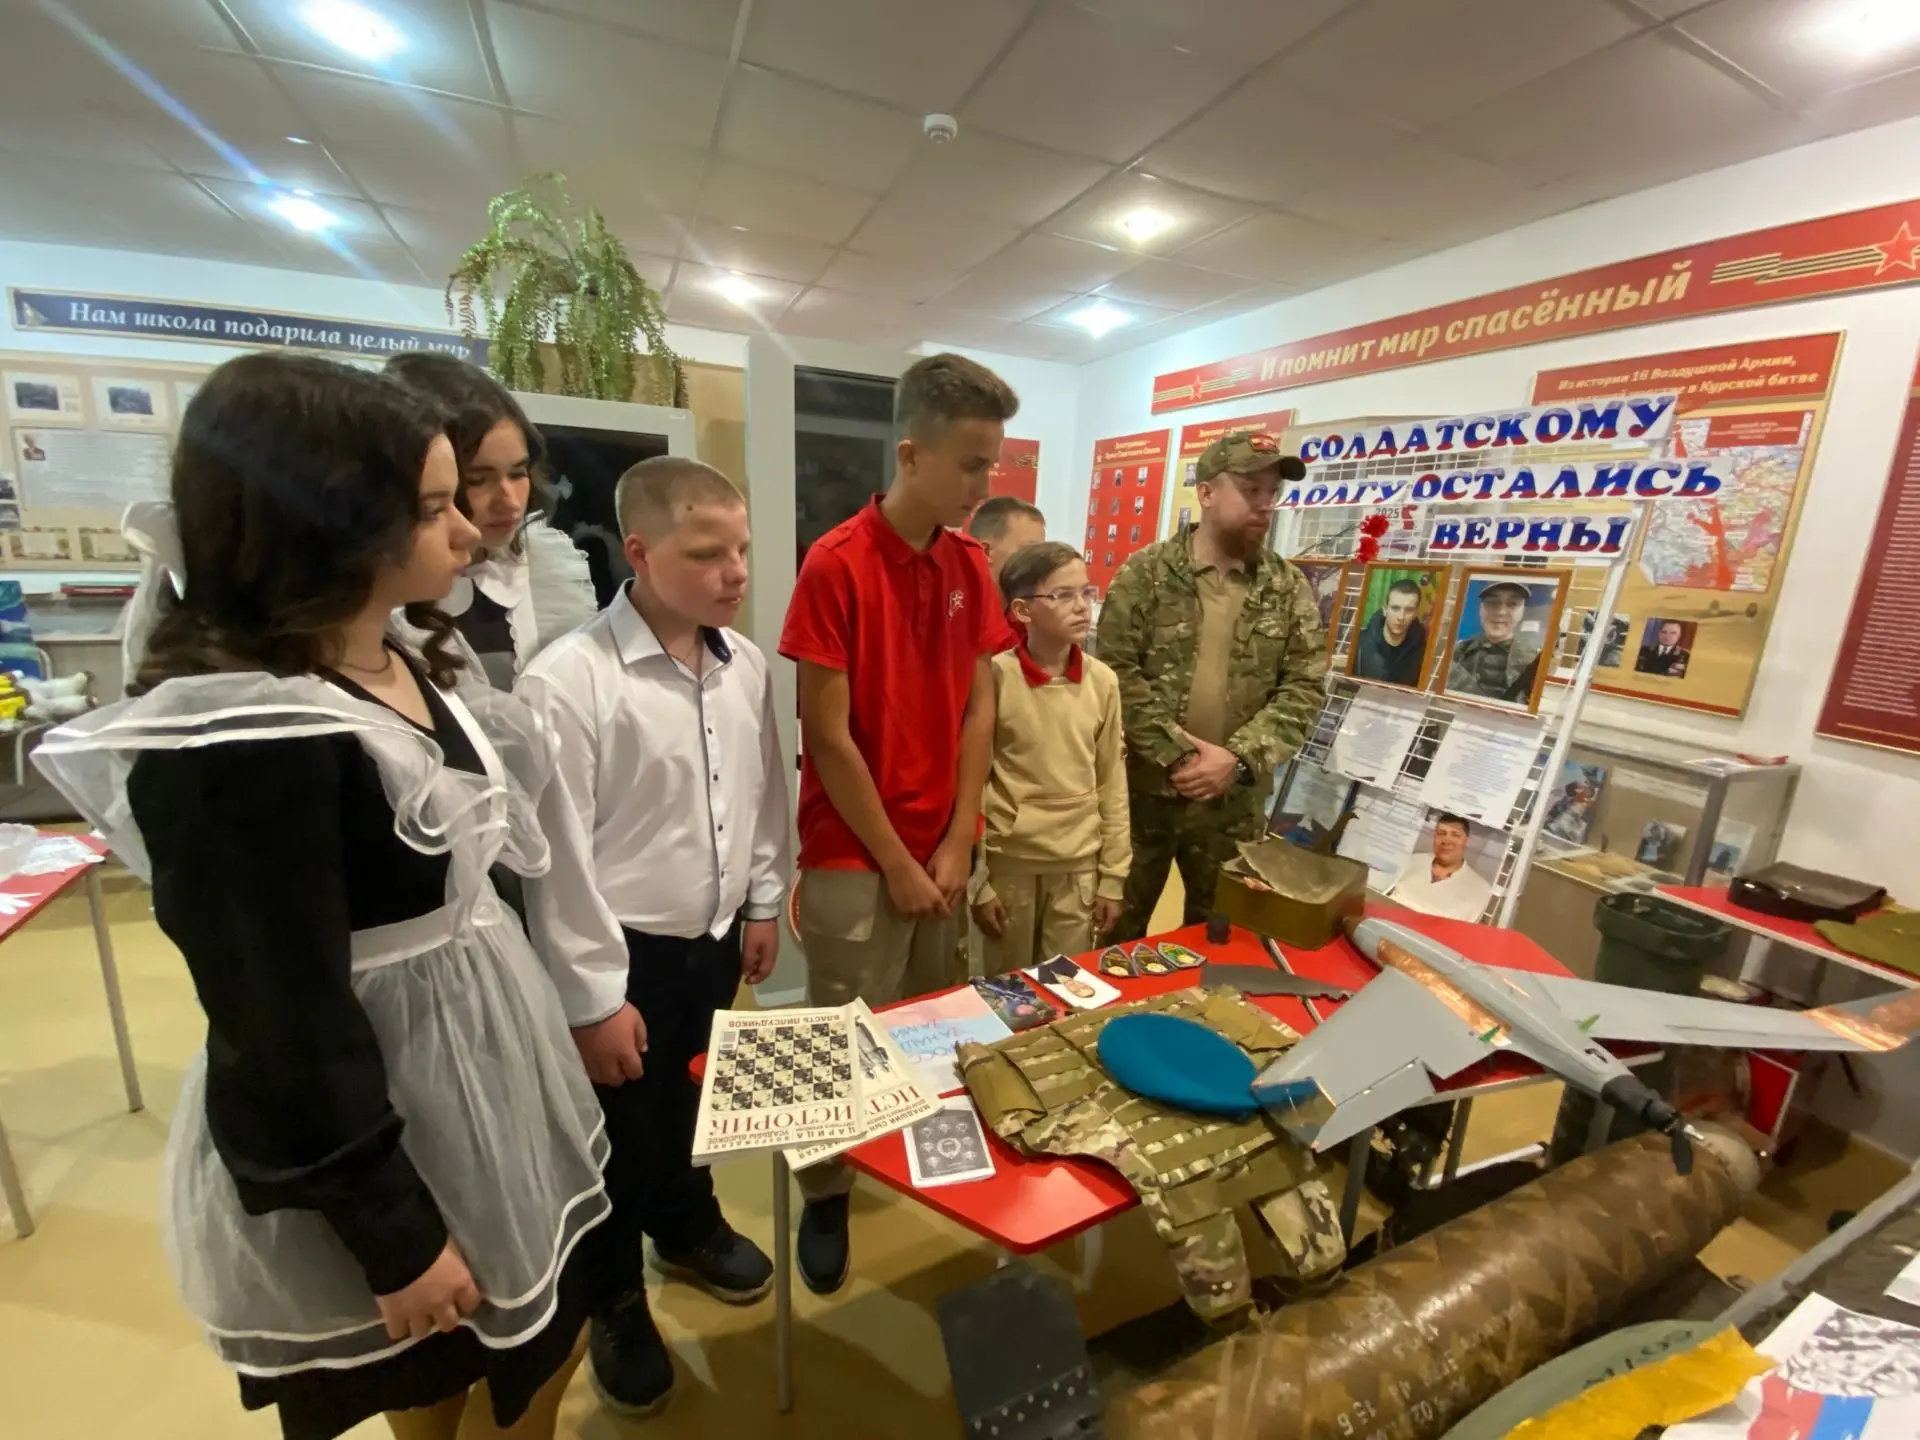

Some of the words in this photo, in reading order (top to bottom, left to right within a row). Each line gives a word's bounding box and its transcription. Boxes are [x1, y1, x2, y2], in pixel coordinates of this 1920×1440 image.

[69, 301, 126, 326] Нам
[135, 311, 217, 333] школа
[224, 316, 342, 345] подарила
[349, 331, 421, 352] целый
[1260, 356, 1276, 382] И
[1278, 339, 1376, 378] помнит
[1377, 325, 1440, 357] мир
[1444, 260, 1693, 344] спасённый
[1575, 374, 1630, 388] истории
[1650, 357, 1738, 380] Воздушной
[1700, 375, 1765, 394] Курской
[1768, 373, 1820, 387] битве
[1300, 395, 1676, 464] СОЛДАТСКОМУ
[1276, 480, 1408, 508] ДОЛГУ
[1411, 460, 1722, 501] ОСТАЛИСЬ
[1429, 515, 1631, 553] ВЕРНЫ
[864, 1085, 920, 1117] ИСТ
[711, 1104, 853, 1136] ИСТОРИК
[796, 1126, 856, 1139] ЦАРИЦА
